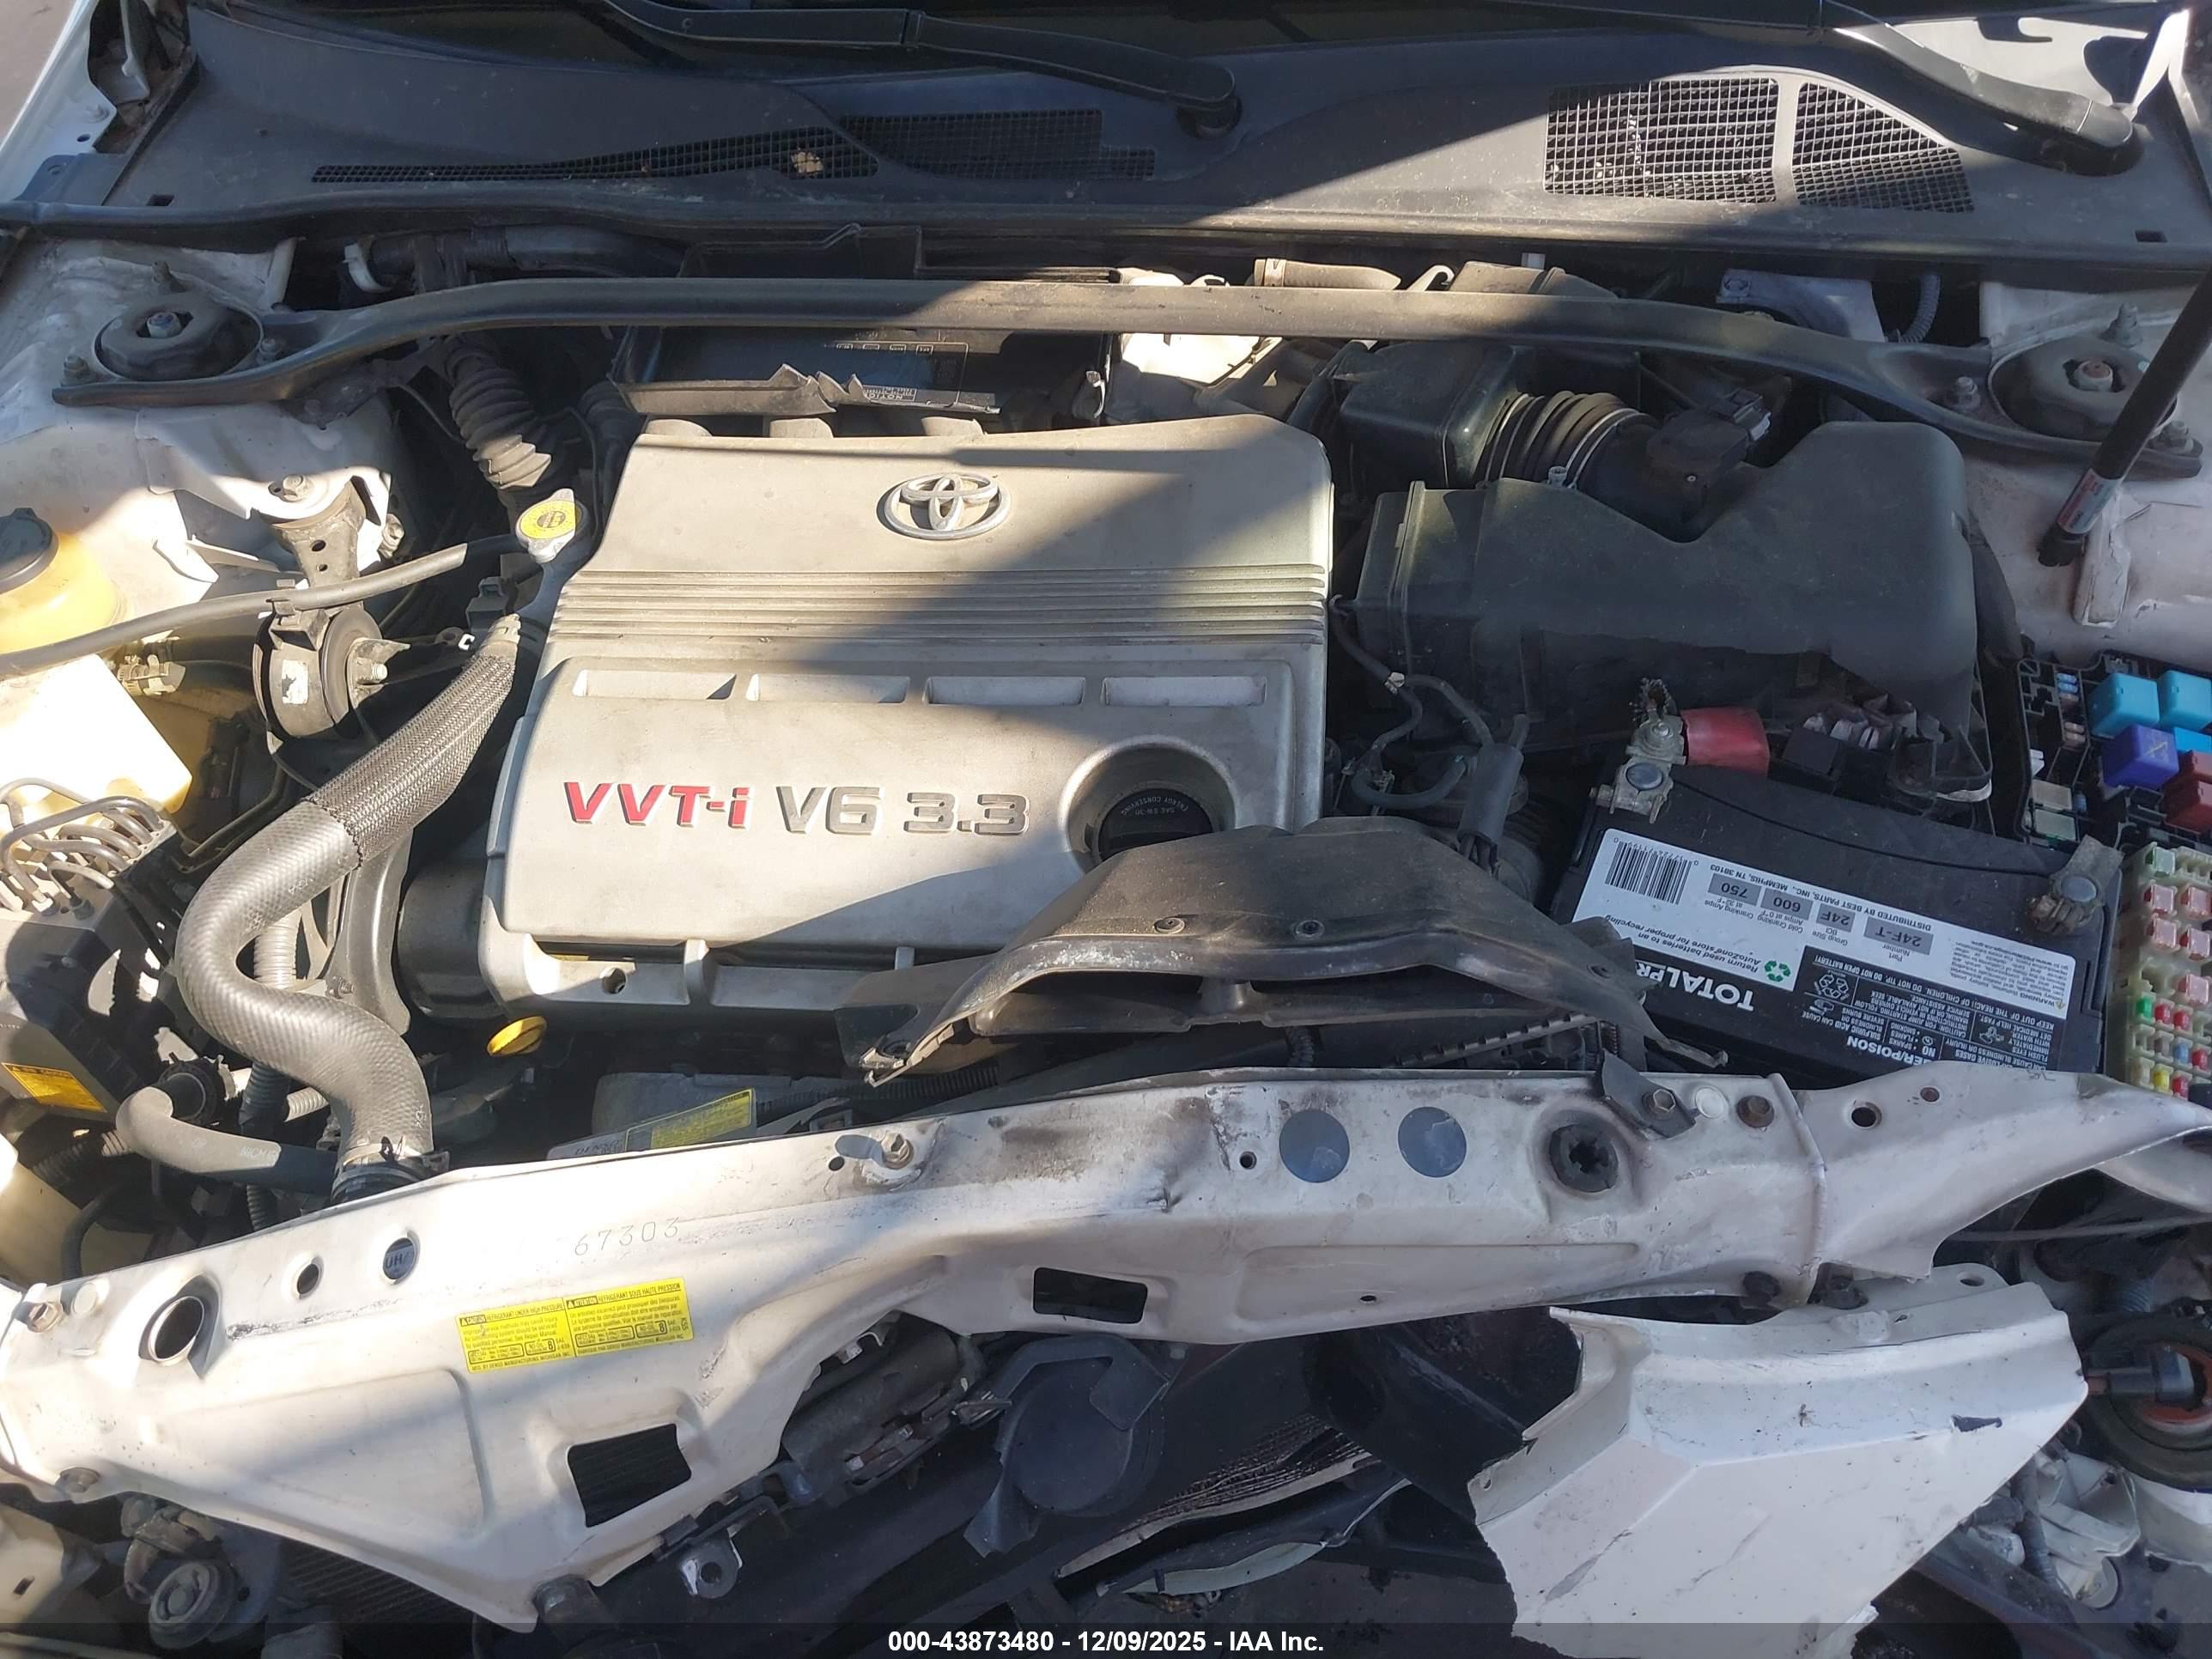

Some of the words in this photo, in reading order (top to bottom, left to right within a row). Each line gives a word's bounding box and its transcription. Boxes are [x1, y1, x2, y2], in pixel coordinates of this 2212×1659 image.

[563, 781, 752, 829] VVT-i
[775, 785, 883, 836] V6
[903, 791, 1030, 836] 3.3
[1709, 863, 1735, 875] 38103
[1735, 871, 1747, 879] TN
[1747, 872, 1789, 890] MEMPHIS,
[1719, 881, 1748, 897] 750
[1704, 898, 1724, 909] Amps
[1771, 896, 1802, 912] 600
[1811, 890, 1840, 906] PARTS,
[1723, 904, 1754, 918] Cranking
[1842, 901, 1863, 912] BEST
[1863, 907, 1875, 915] BY
[1603, 914, 1645, 931] recycling
[1756, 914, 1787, 928] Cranking
[1784, 915, 1803, 926] Amps
[1820, 908, 1850, 926] 24F
[1876, 910, 1931, 932] DISTRIBUTED
[1645, 926, 1676, 939] proper
[1787, 923, 1803, 933] Cold
[1637, 932, 1650, 940] an
[1675, 935, 1690, 945] for
[1812, 930, 1826, 939] Size
[1827, 934, 1848, 945] Group
[1875, 925, 1922, 947] 24F-T
[1661, 939, 1702, 955] batteries
[1691, 940, 1715, 951] store
[1881, 943, 1910, 956] Number
[1702, 951, 1725, 963] used
[1814, 955, 1844, 969] BATTERY!
[1888, 952, 1903, 961] Part
[1726, 957, 1758, 972] Return
[1843, 963, 1860, 974] OPEN
[1860, 968, 1873, 978] NOT
[1873, 971, 1882, 981] DO
[1629, 957, 1759, 1011] TOTALPR
[1884, 975, 1896, 984] TIP.
[1897, 979, 1911, 988] NOT
[1911, 982, 1922, 992] DO
[1933, 989, 1960, 1003] CHILDREN.
[1960, 997, 1970, 1006] OF
[2020, 991, 2054, 1006] WARNING
[1854, 1000, 1877, 1011] FOLLOW
[1971, 1000, 1994, 1012] REACH
[1995, 1006, 2008, 1017] THE
[1801, 1011, 1820, 1022] CAUSE
[1841, 1006, 1862, 1018] BURNS
[1862, 1012, 1885, 1024] SEVERE
[2010, 1011, 2020, 1020] OF
[1820, 1016, 1833, 1025] CAN
[1834, 1020, 1850, 1030] ACID
[1850, 1017, 1882, 1031] BLINDNESS
[1908, 1015, 1923, 1025] JUMP
[1924, 1020, 1936, 1029] FOR
[2021, 1014, 2035, 1024] OUT
[2036, 1018, 2054, 1030] KEEP
[1850, 1024, 1881, 1039] SULFURIC
[1890, 1021, 1916, 1034] SMOKING
[1890, 1030, 1914, 1042] FLAMES
[1888, 1036, 1912, 1049] SPARKS
[1921, 1045, 1936, 1057] NO
[2011, 1046, 2027, 1055] EYES
[2027, 1050, 2047, 1061] FLUSH
[574, 1217, 679, 1255] 67303
